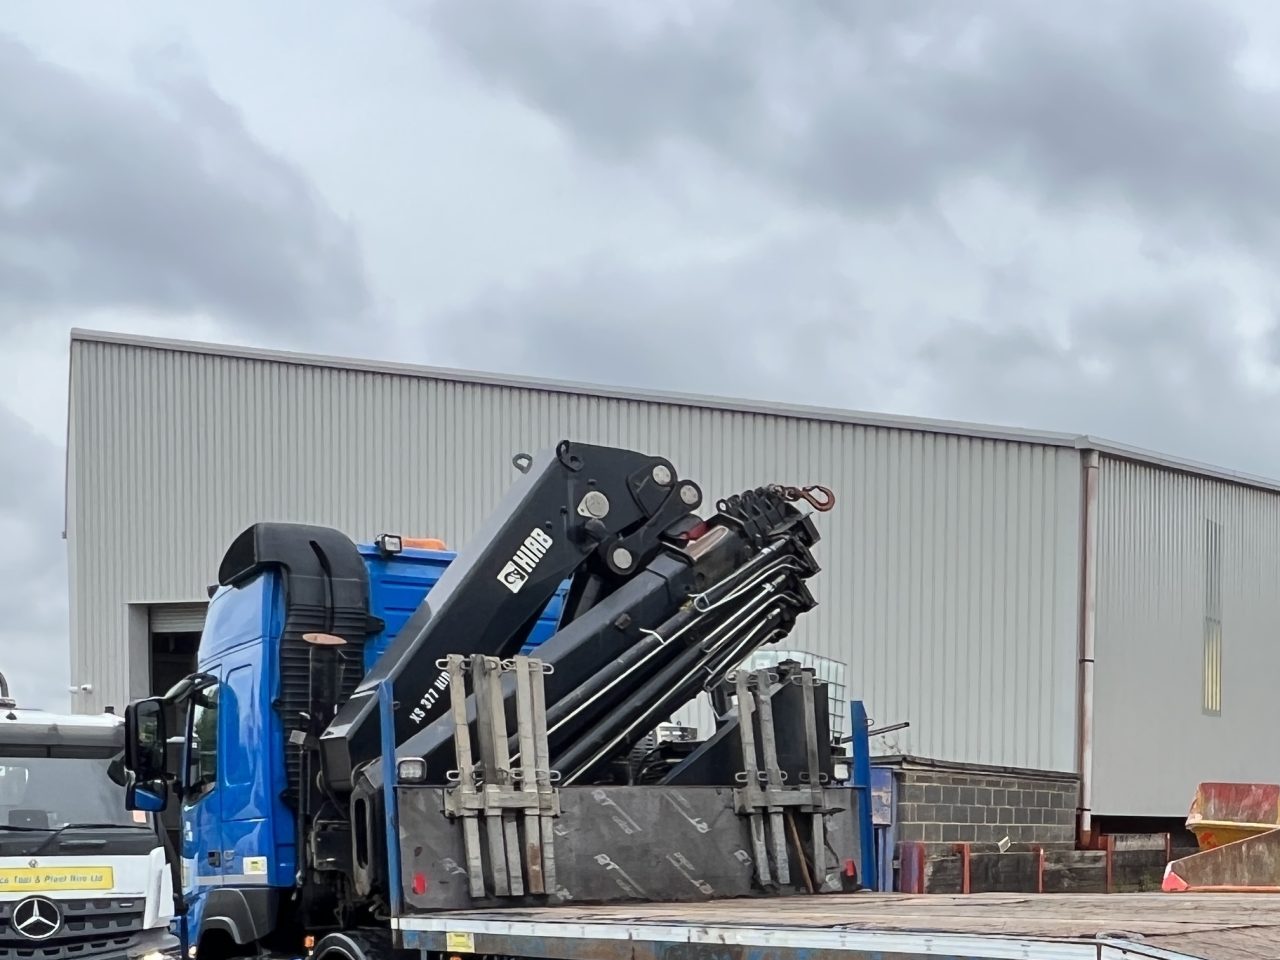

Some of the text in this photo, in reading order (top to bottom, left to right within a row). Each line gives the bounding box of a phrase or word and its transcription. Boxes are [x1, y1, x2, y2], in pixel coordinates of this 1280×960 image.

[512, 527, 553, 573] HIAB
[409, 707, 426, 724] XS
[420, 688, 439, 709] 377
